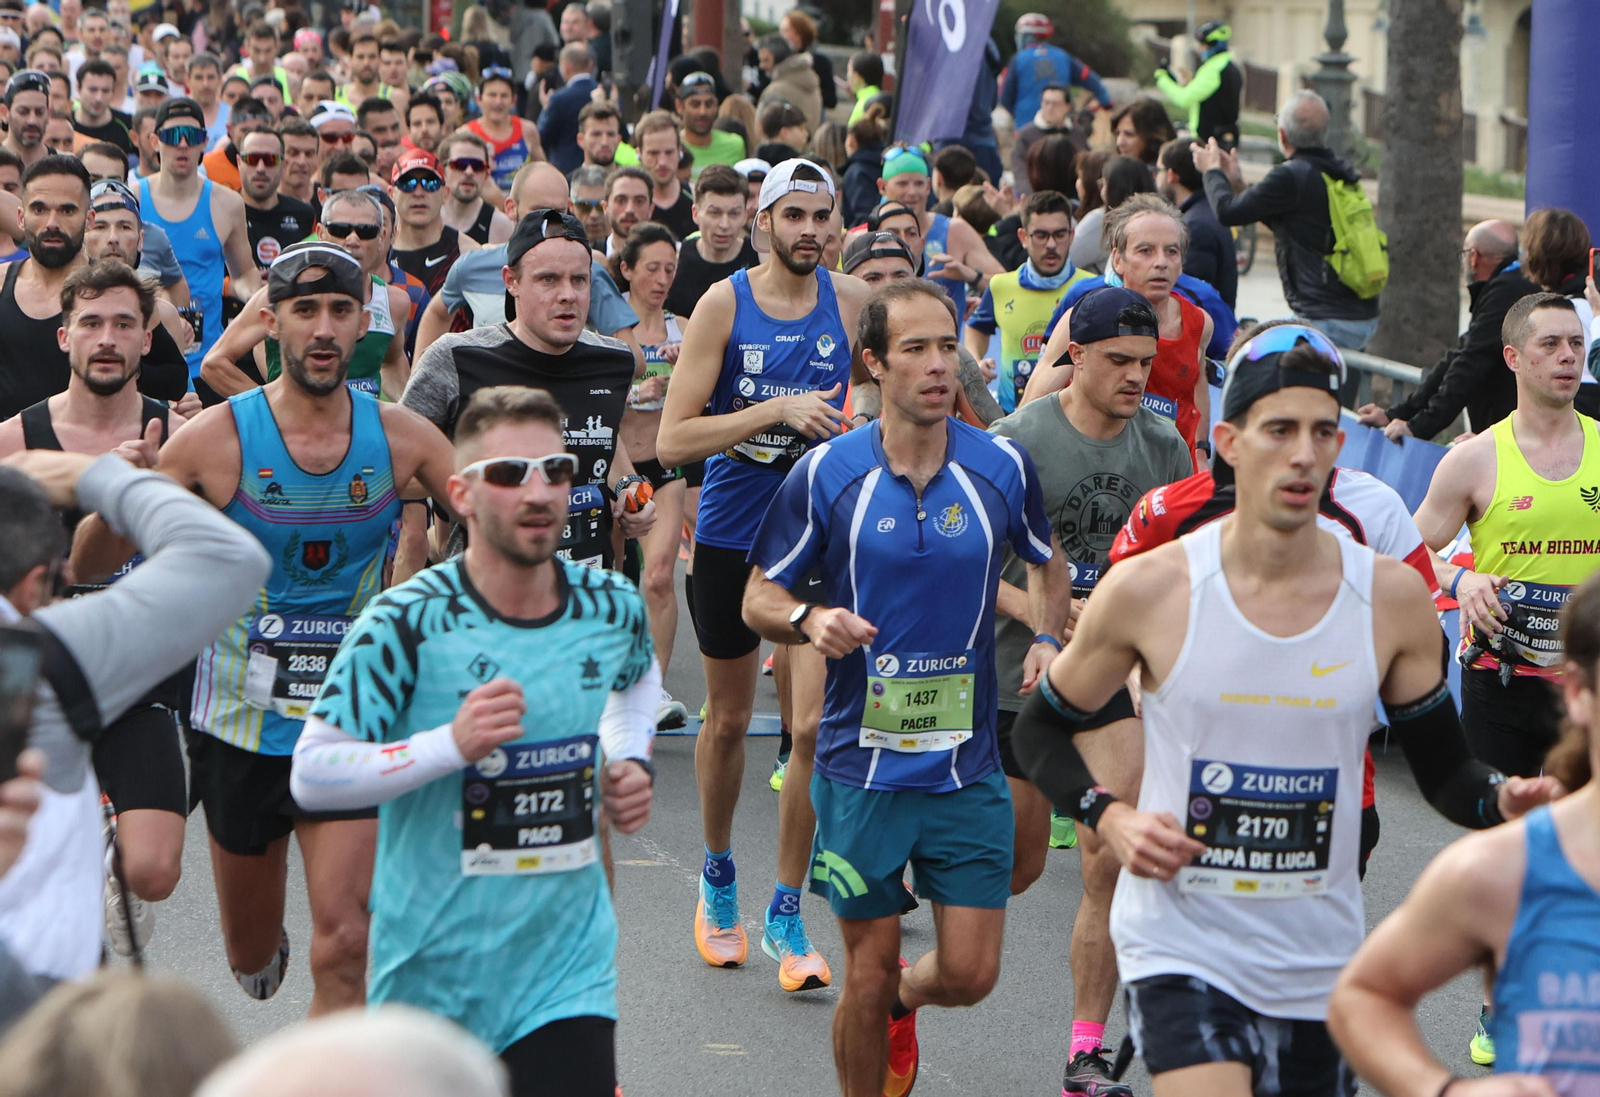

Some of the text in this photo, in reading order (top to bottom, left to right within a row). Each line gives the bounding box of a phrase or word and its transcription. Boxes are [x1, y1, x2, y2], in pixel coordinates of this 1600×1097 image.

[1140, 396, 1172, 414] ZURIC
[568, 490, 592, 505] ICH
[1067, 476, 1134, 512] DARES
[1500, 541, 1542, 554] TEAM
[1526, 616, 1560, 631] 2668
[1502, 625, 1530, 644] TEAM
[288, 654, 328, 672] 2838
[905, 690, 938, 706] 1437
[900, 716, 937, 730] PACER
[1242, 772, 1325, 794] ZURICH
[514, 789, 565, 816] 2172
[518, 824, 564, 846] PACO
[1236, 815, 1290, 840] 2170
[1201, 846, 1317, 870] PAPÁ DE LUCA
